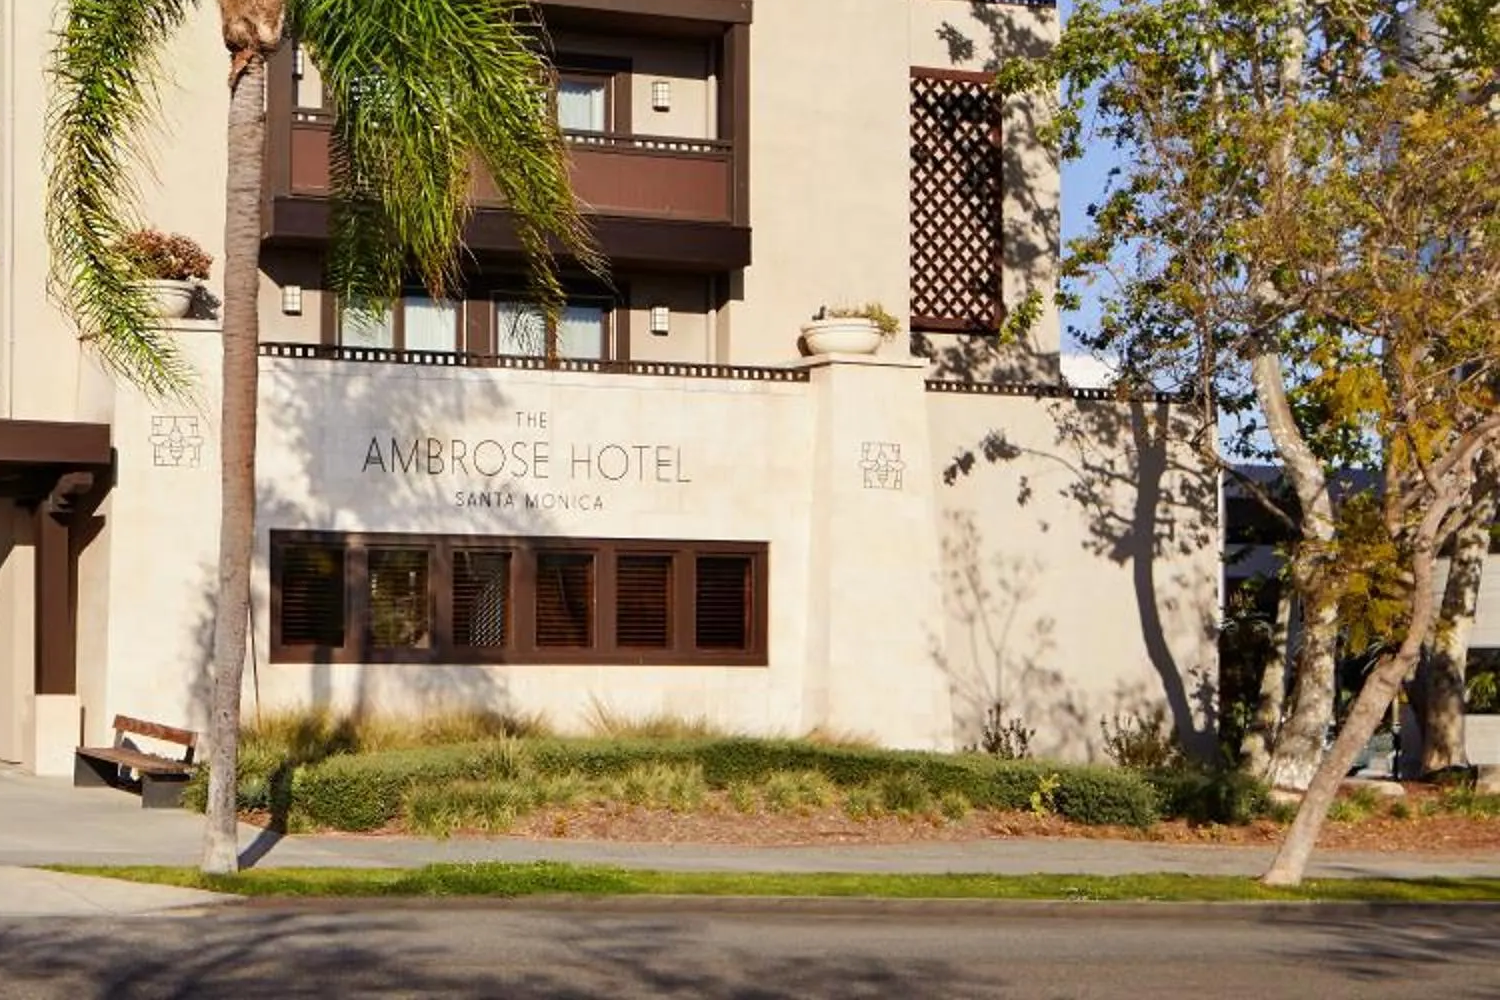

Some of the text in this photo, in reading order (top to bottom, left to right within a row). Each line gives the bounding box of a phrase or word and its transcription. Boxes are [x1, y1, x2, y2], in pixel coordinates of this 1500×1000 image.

[516, 411, 547, 429] THE
[362, 436, 692, 483] AMBROSE HOTEL
[455, 491, 604, 511] SANTA MONICA
